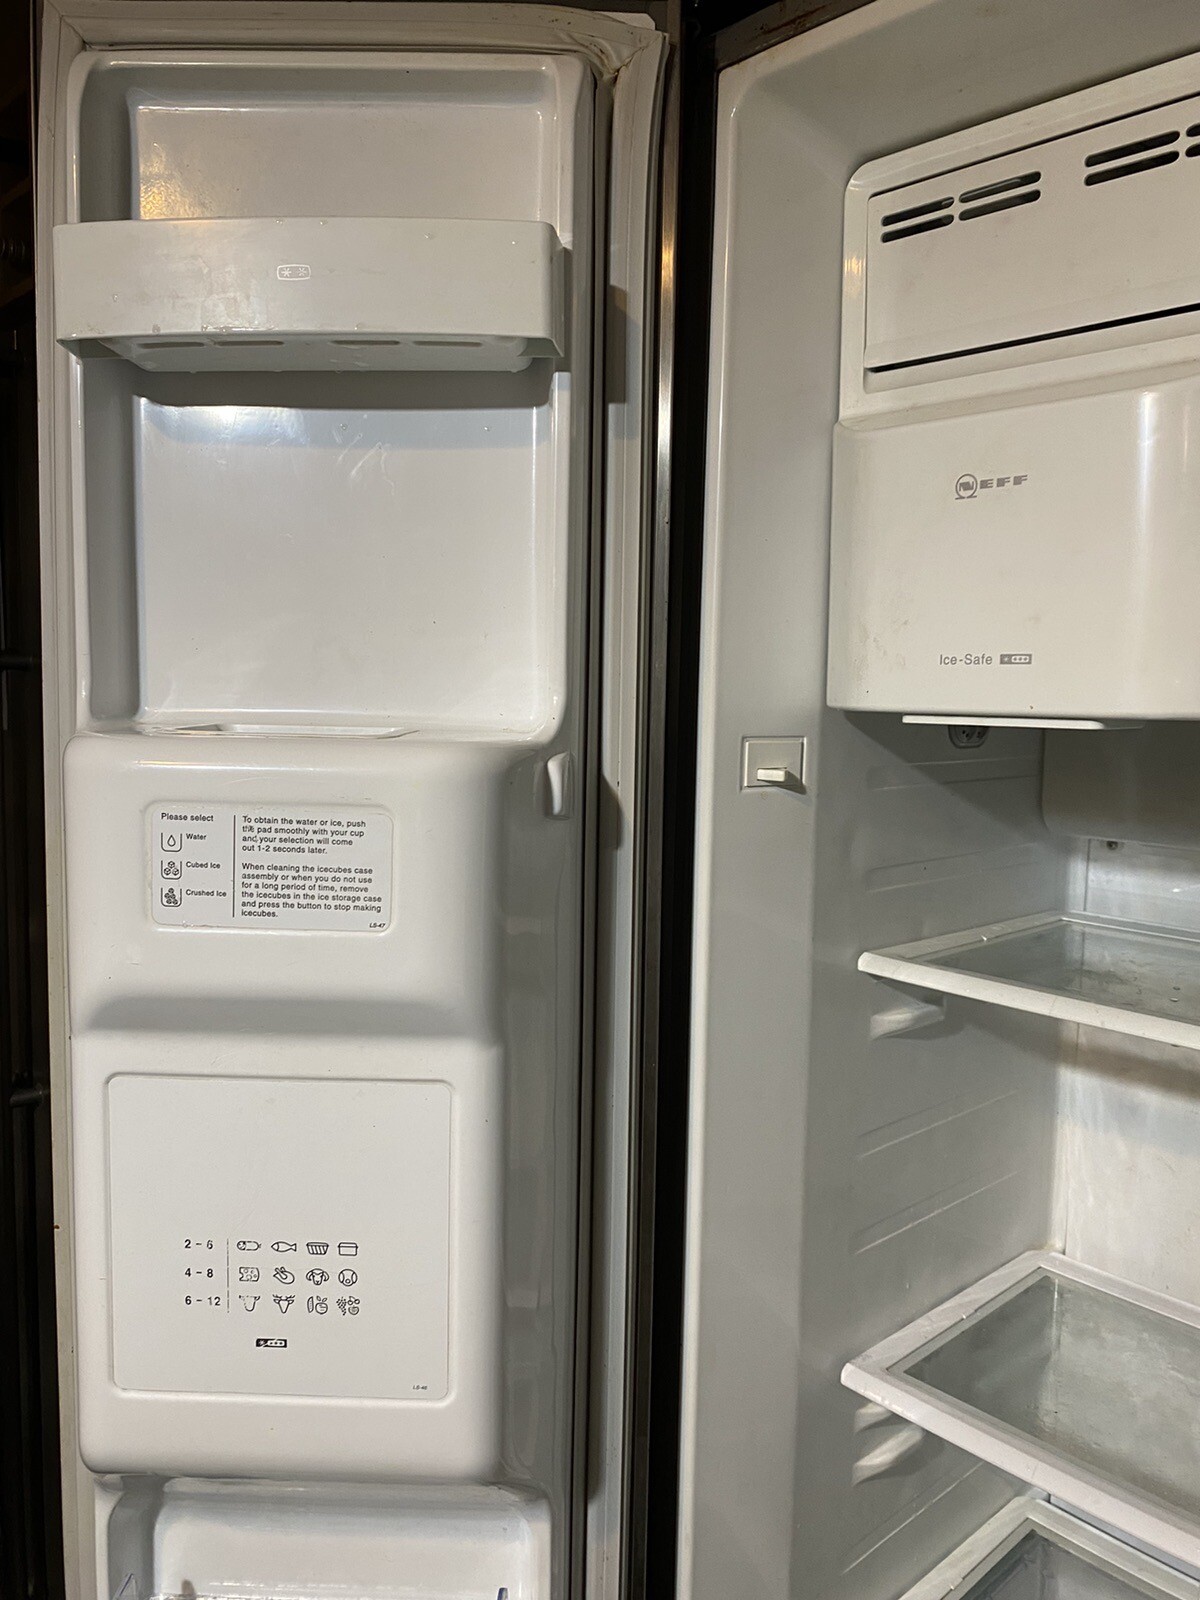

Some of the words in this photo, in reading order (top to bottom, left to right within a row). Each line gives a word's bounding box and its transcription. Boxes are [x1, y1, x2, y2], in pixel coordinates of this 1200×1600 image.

[955, 473, 1028, 500] NEFF
[939, 653, 993, 665] Ice-Safe
[161, 813, 188, 821] Please
[190, 814, 214, 822] select
[242, 816, 252, 824] To
[254, 816, 279, 825] obtain
[280, 817, 293, 825] the
[330, 819, 344, 827] ice,
[346, 820, 366, 828] push
[186, 833, 207, 841] Water
[257, 826, 272, 835] pad
[274, 827, 309, 837] smoothly
[312, 828, 328, 836] with
[330, 829, 348, 838] your
[350, 830, 364, 838] cup
[259, 837, 277, 845] your
[279, 836, 314, 844] selection
[186, 861, 208, 869] Cubed
[242, 863, 265, 871] When
[267, 864, 300, 873] cleaning
[302, 865, 315, 873] the
[317, 866, 352, 874] icecubes
[242, 873, 279, 882] assembly
[291, 874, 312, 882] when
[314, 876, 329, 884] you
[242, 881, 253, 889] for
[262, 882, 279, 892] long
[281, 883, 306, 892] period
[308, 883, 316, 891] of
[318, 884, 337, 893] time,
[186, 889, 215, 897] Crushed
[242, 891, 254, 899] the
[256, 891, 291, 900] icecubes
[302, 892, 315, 900] the
[318, 893, 330, 901] ice
[332, 894, 361, 903] storage
[258, 902, 280, 910] press
[282, 901, 295, 909] the
[297, 902, 322, 910] button
[334, 904, 351, 912] stop
[353, 904, 382, 913] making
[241, 910, 278, 918] icecubes.
[207, 1296, 221, 1306] 12
